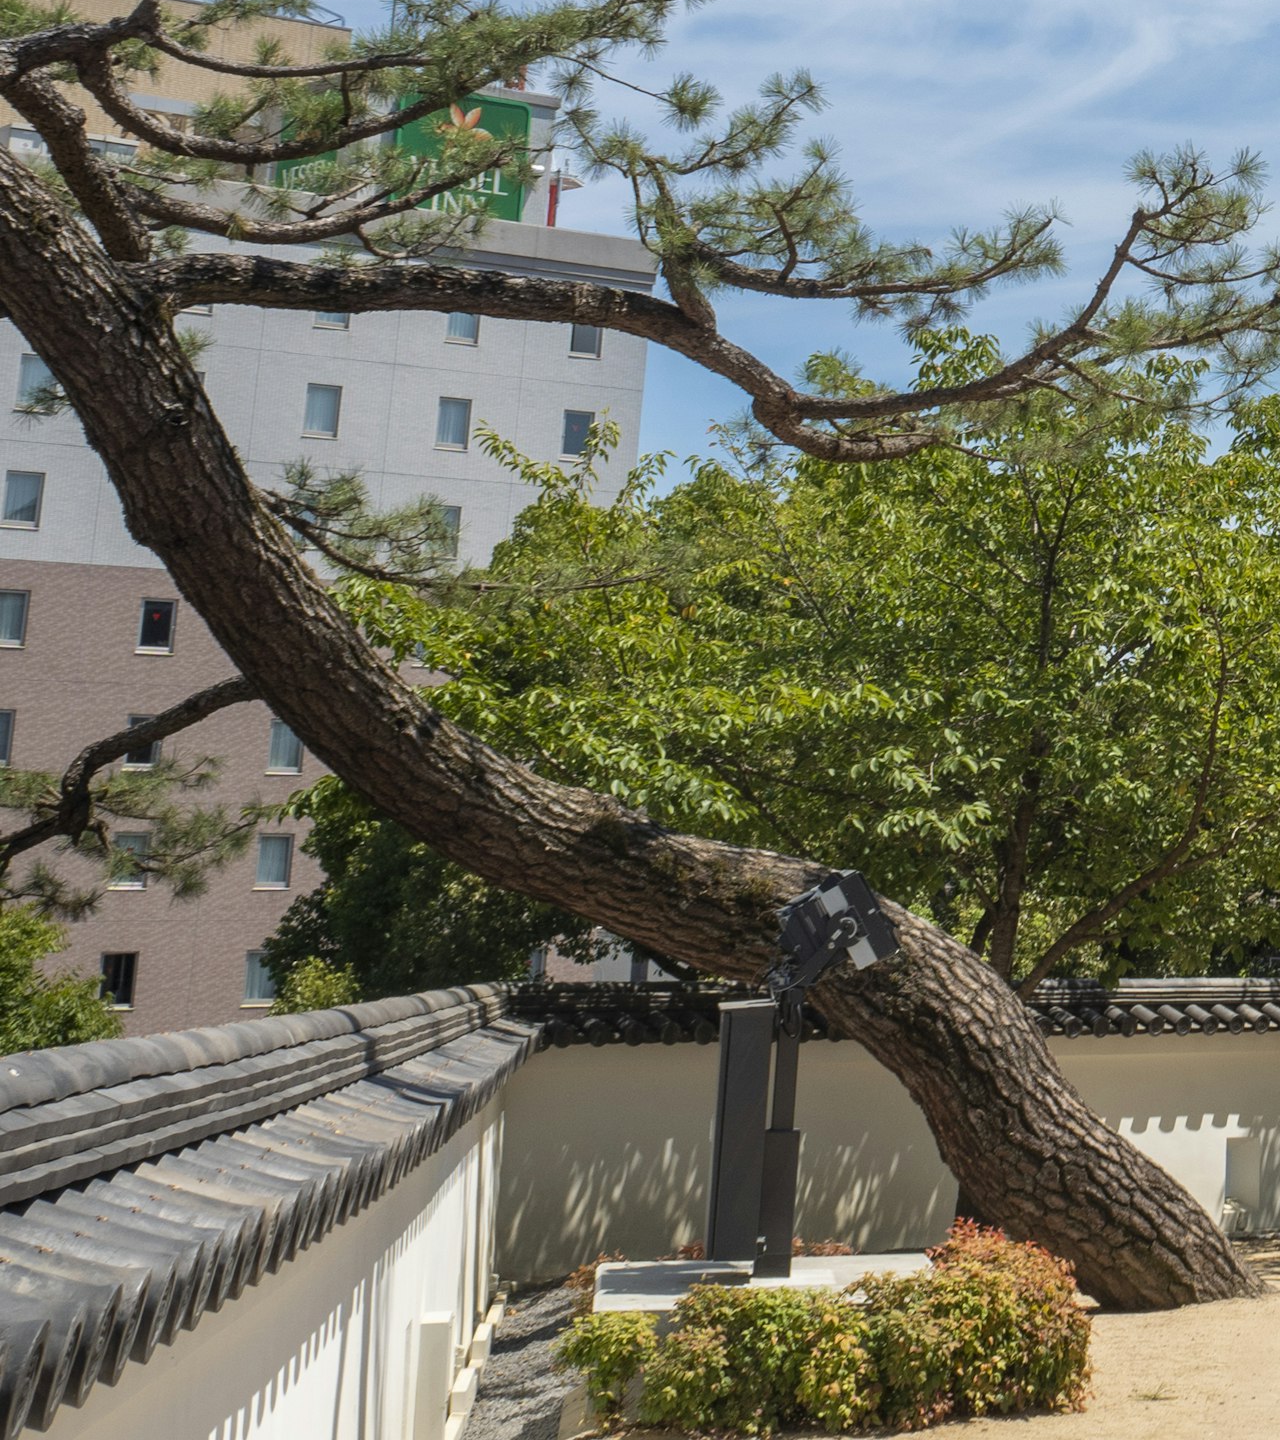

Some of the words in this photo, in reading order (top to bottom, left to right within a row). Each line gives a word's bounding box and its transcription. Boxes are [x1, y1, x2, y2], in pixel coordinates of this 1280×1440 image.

[282, 159, 334, 191] VESSE
[410, 155, 509, 196] VEEL
[430, 190, 487, 216] INN
